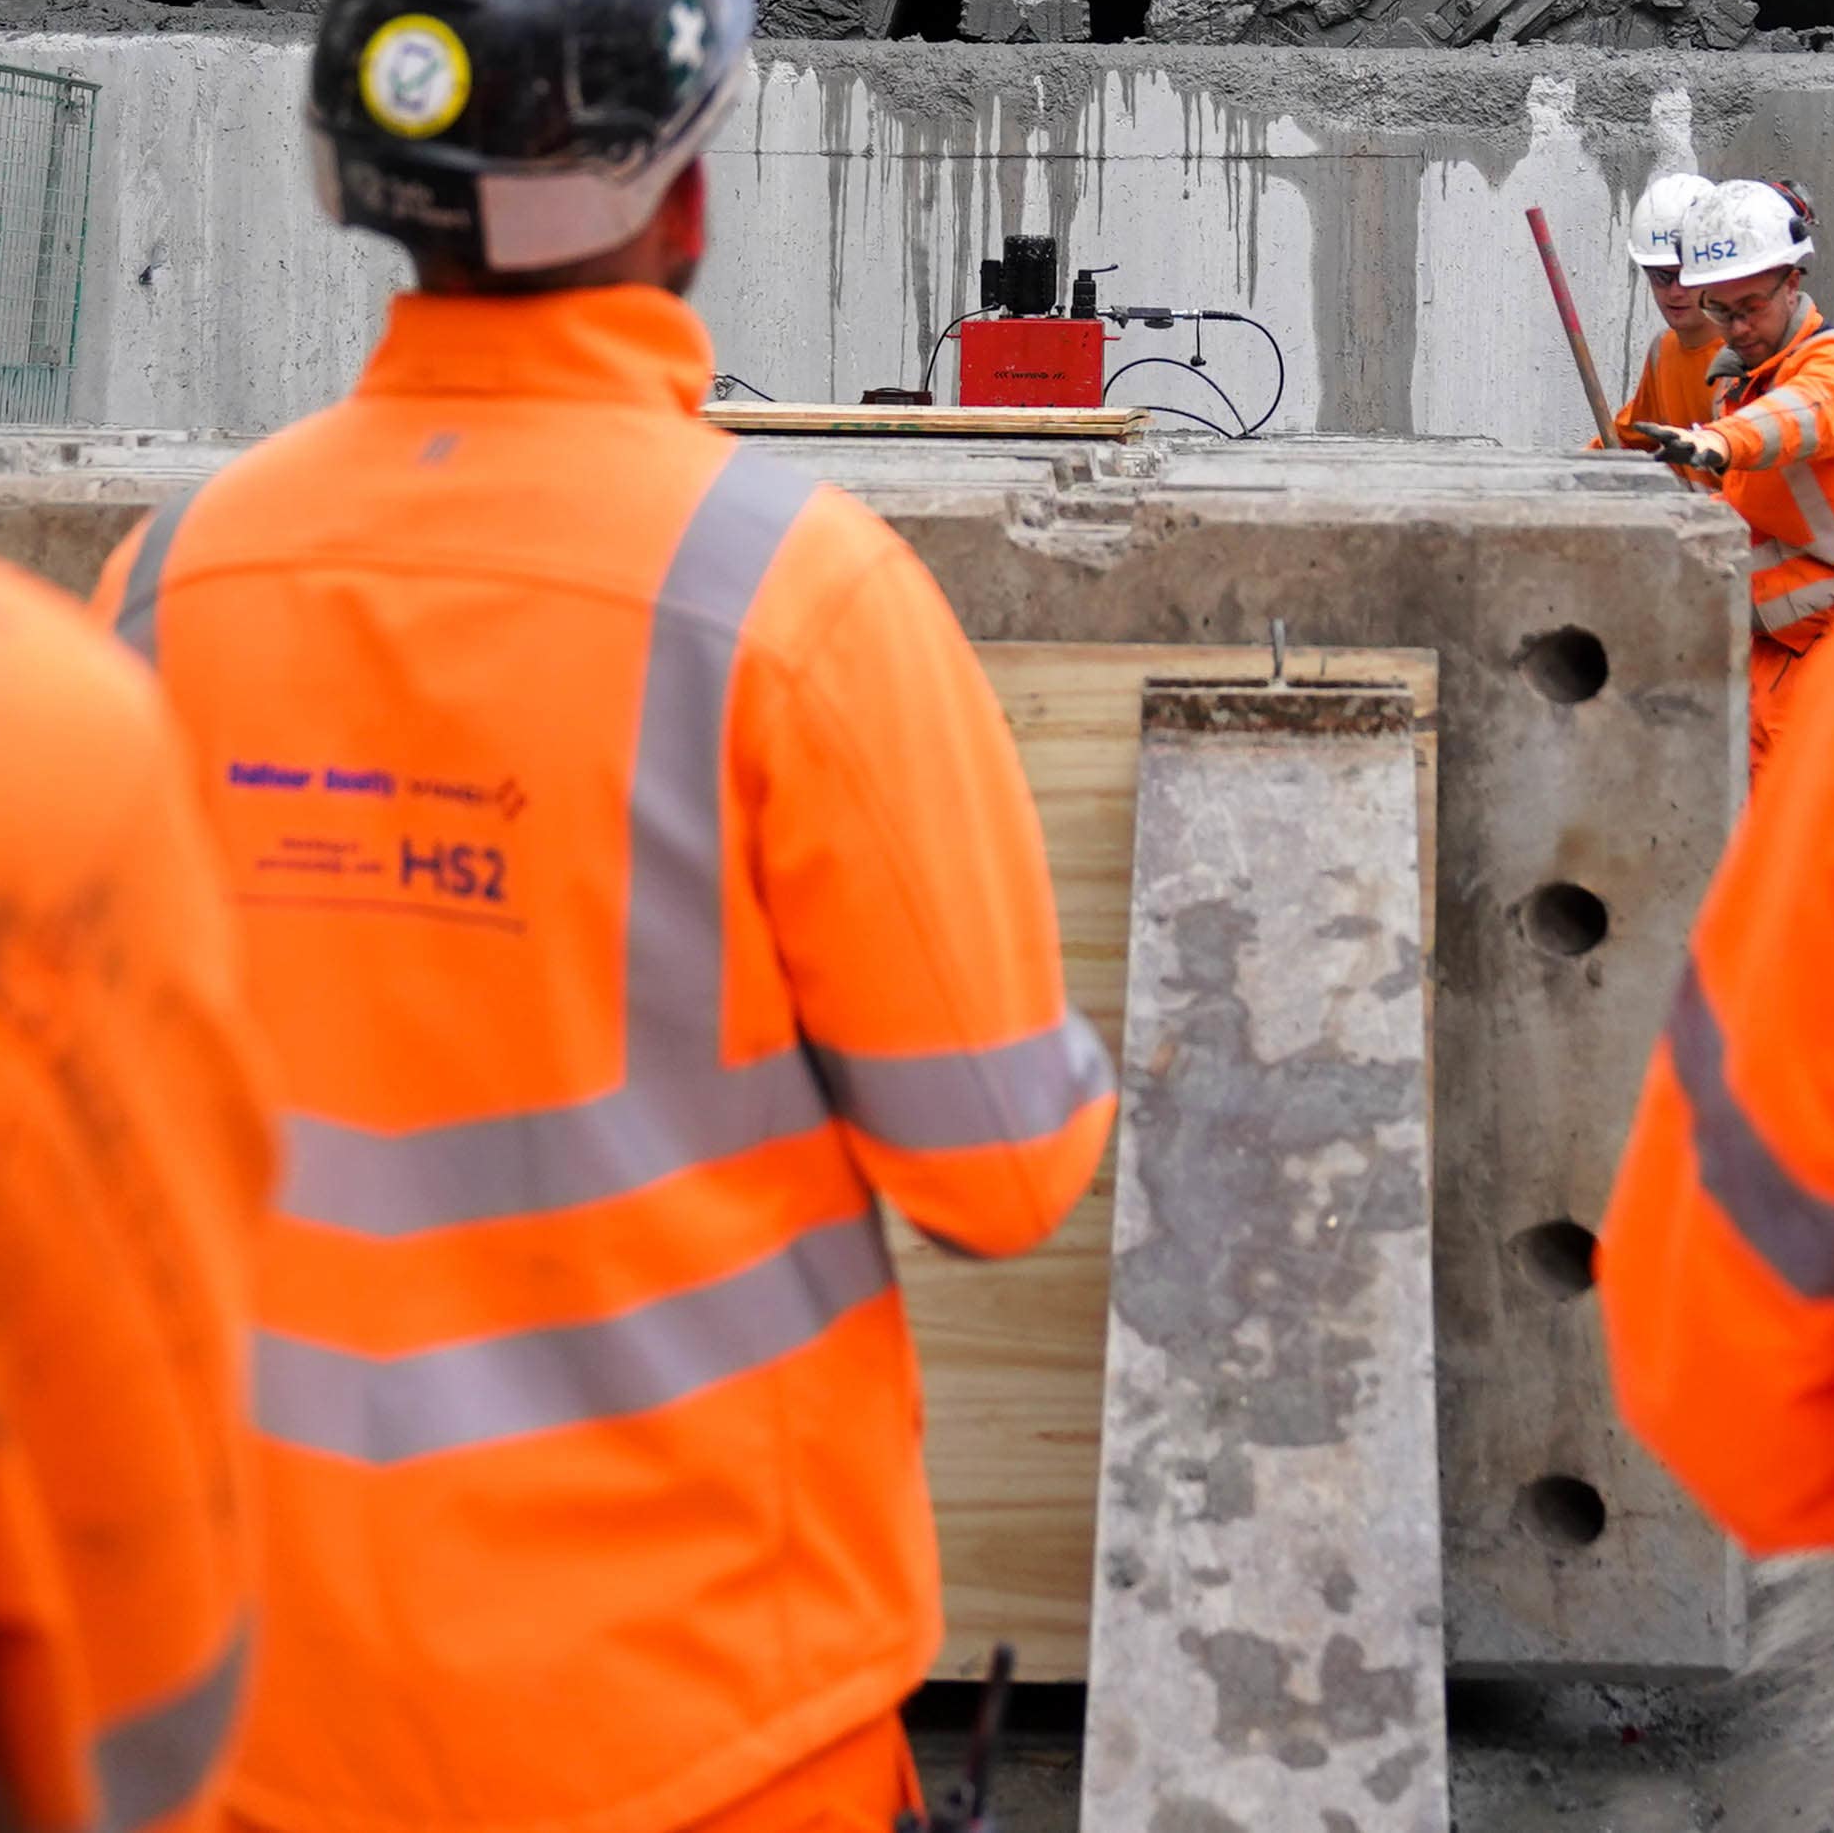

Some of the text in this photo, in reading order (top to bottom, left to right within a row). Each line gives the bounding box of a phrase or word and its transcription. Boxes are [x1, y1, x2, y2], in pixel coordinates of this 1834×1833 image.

[1652, 229, 1680, 246] HS
[1692, 239, 1738, 264] HS2
[400, 838, 505, 902] HS2
